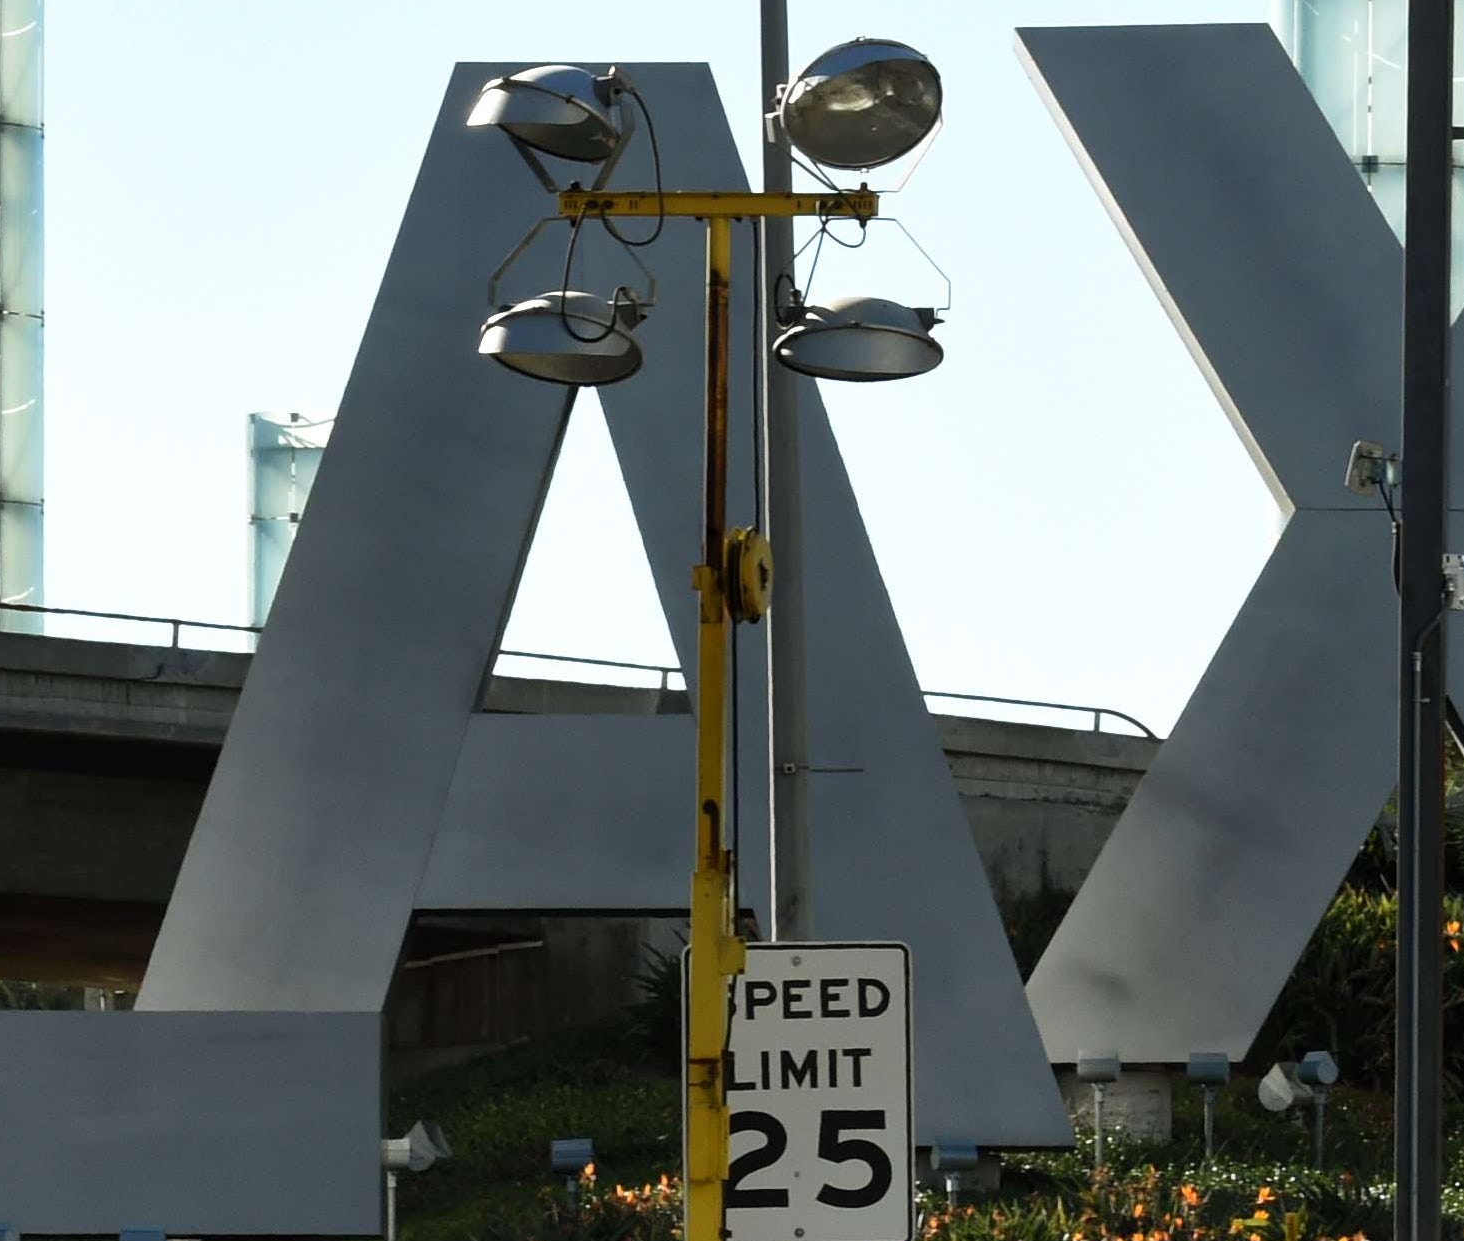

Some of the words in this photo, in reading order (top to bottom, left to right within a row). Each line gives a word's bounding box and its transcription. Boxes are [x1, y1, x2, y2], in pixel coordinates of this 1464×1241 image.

[728, 978, 890, 1020] PEED
[725, 1048, 872, 1091] LIMIT
[726, 1110, 892, 1209] 25
